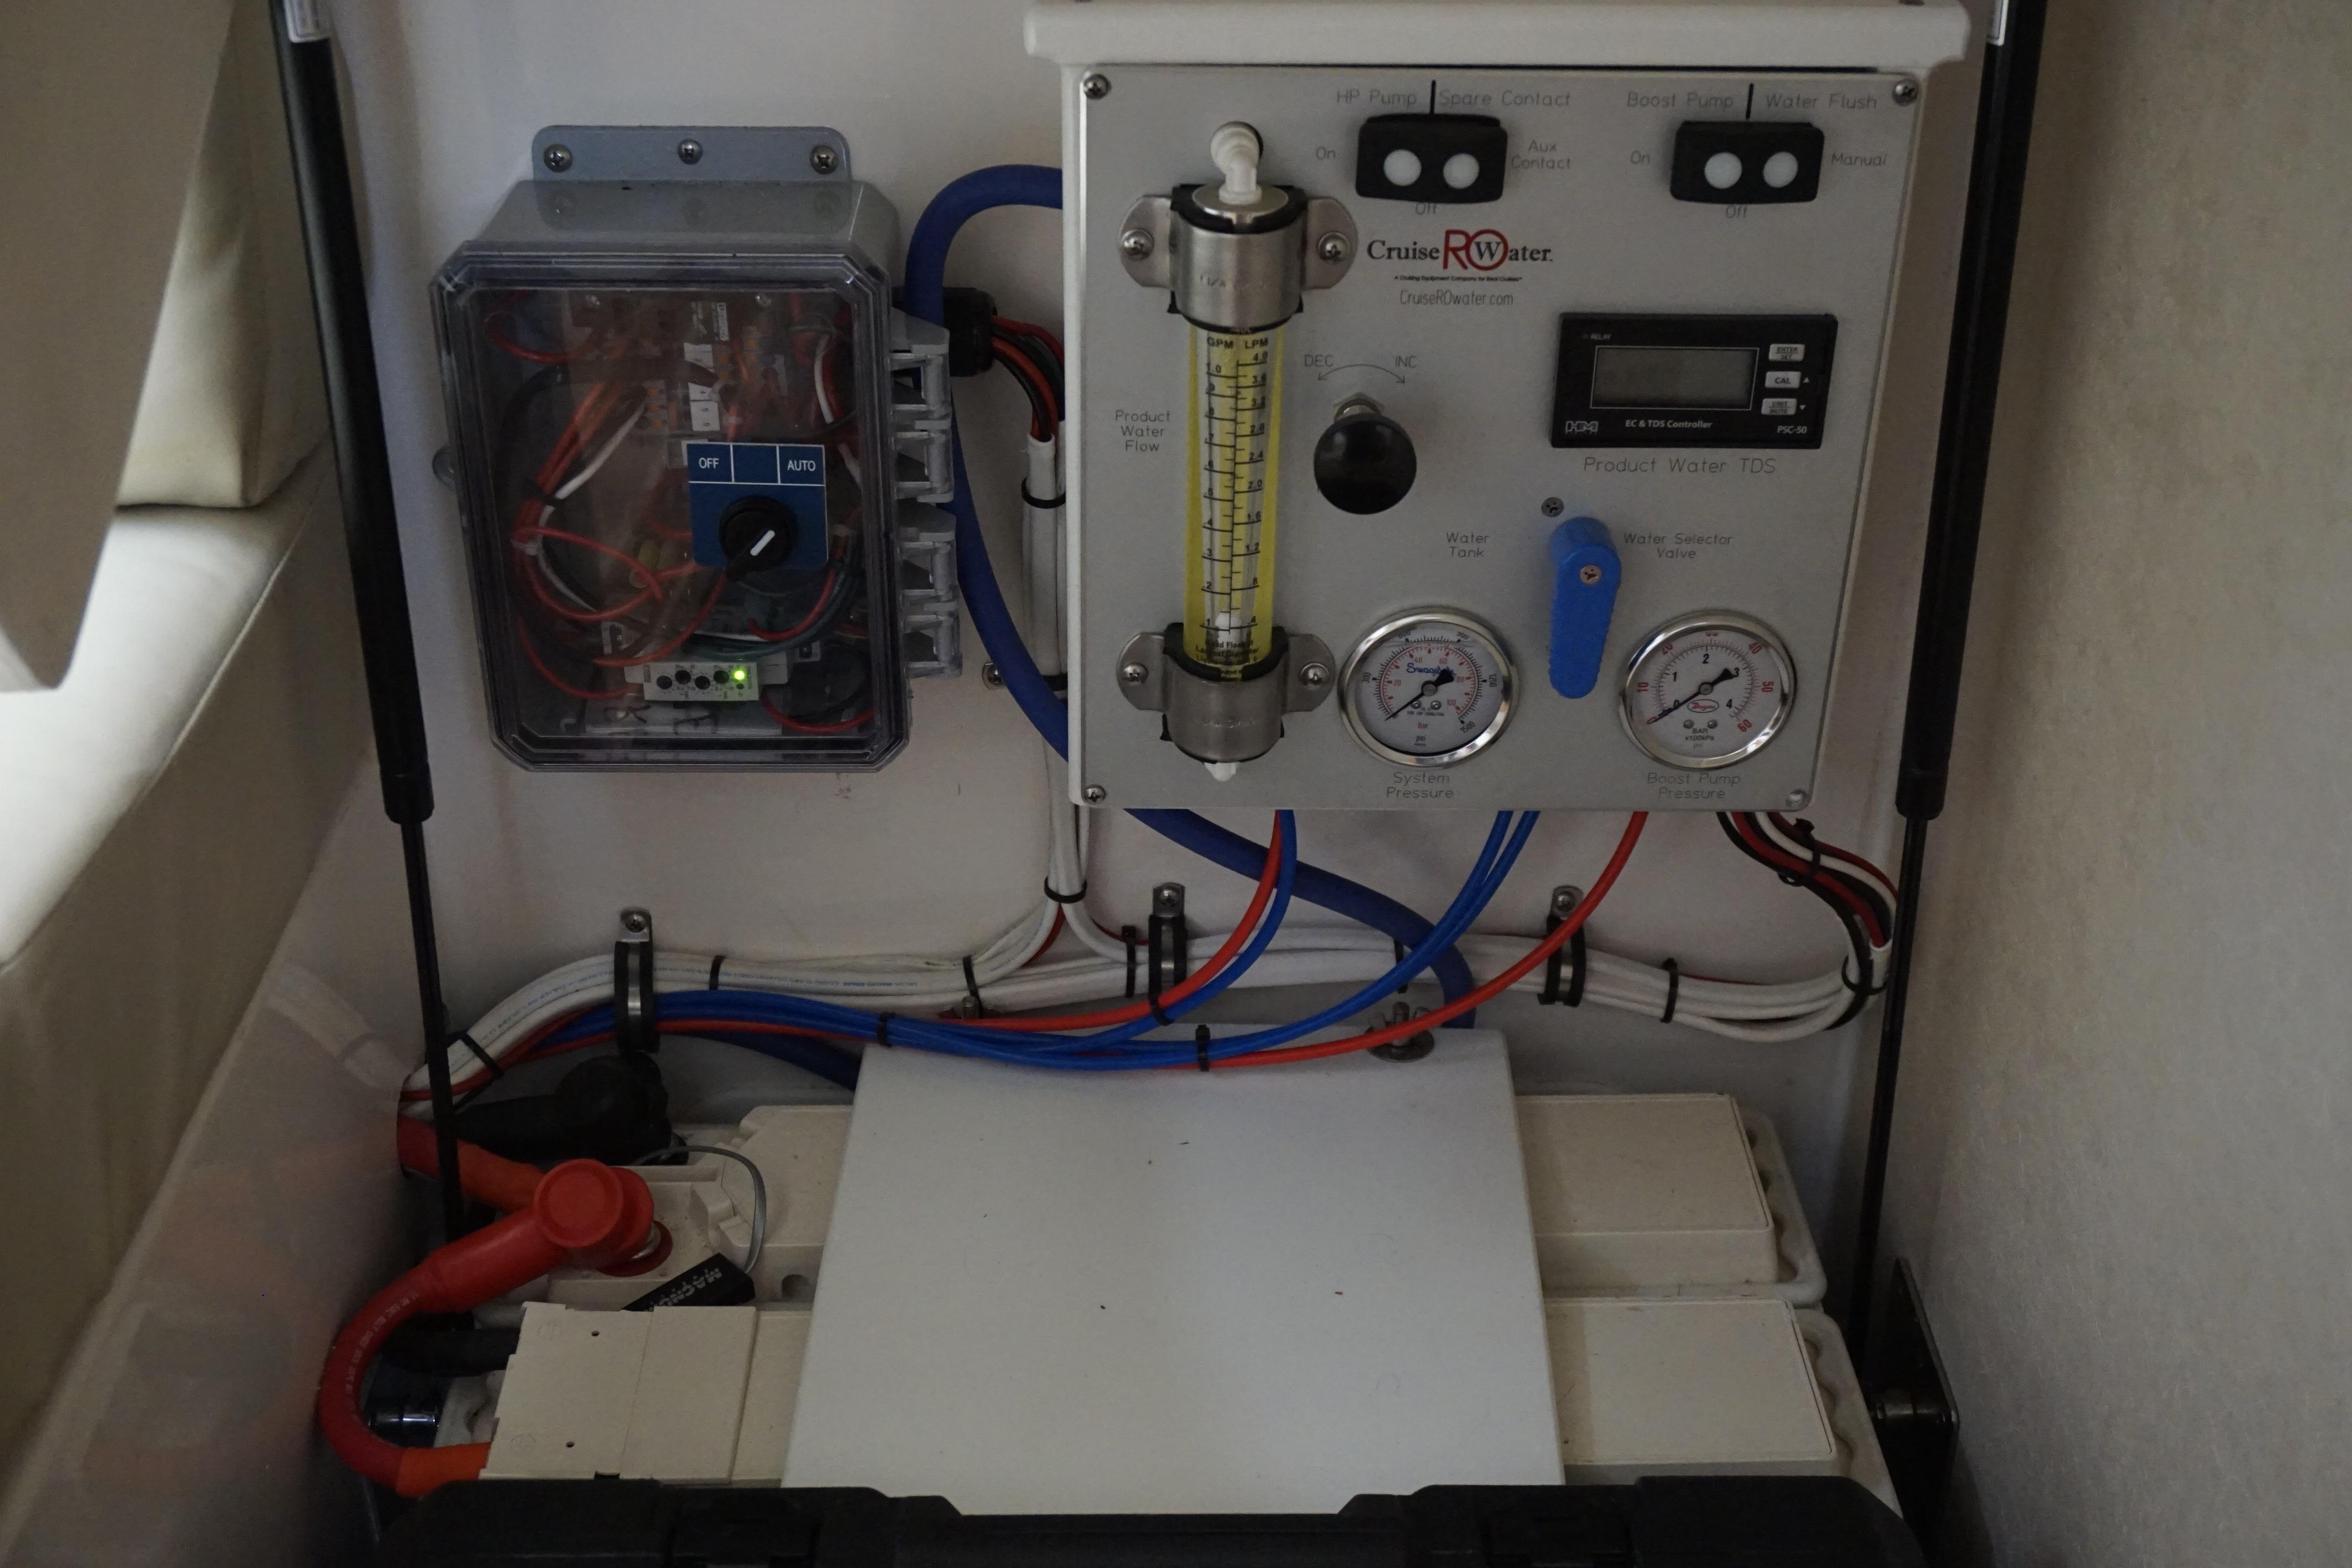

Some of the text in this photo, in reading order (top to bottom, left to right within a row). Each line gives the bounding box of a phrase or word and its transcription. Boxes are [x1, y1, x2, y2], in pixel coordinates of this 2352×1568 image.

[1337, 89, 1417, 106] HP Pump
[1439, 90, 1571, 106] Spare Contact
[1628, 92, 1733, 110] Boost Pump
[1766, 93, 1877, 109] Water Flush
[1316, 146, 1336, 160] On
[1528, 140, 1557, 153] Aux
[1511, 155, 1571, 170] Contact
[1630, 150, 1650, 165] On
[1832, 153, 1887, 166] Manual
[1416, 202, 1438, 215] Off
[1726, 205, 1748, 219] Off
[1207, 336, 1234, 348] GPM
[1245, 337, 1268, 349] LPM
[1304, 354, 1334, 368] DEC
[1395, 355, 1417, 368] INC
[1115, 409, 1171, 423] Product
[1625, 419, 1713, 429] EC & TDS Controller
[1777, 425, 1807, 434] PSC-50
[1121, 425, 1165, 438] Water
[1125, 439, 1160, 453] Flow
[698, 457, 720, 469] OFF
[787, 460, 817, 472] AUTO
[1584, 457, 1776, 474] Product Water TDS
[1446, 531, 1489, 544] Water
[1624, 532, 1734, 545] Water Selector
[1449, 546, 1484, 558] Tank
[1656, 548, 1696, 559] Valve
[1748, 642, 1762, 654] 40
[1702, 653, 1710, 664] 2
[1406, 662, 1457, 676] Swagelk
[1733, 667, 1740, 678] 3
[1361, 672, 1372, 684] 300
[1489, 674, 1498, 688] 1200
[1672, 671, 1677, 682] 1
[1636, 682, 1649, 693] 10
[1762, 681, 1775, 693] 50
[1673, 699, 1680, 709] 0
[1726, 699, 1733, 709] 4
[1460, 720, 1476, 734] 1500
[1737, 719, 1753, 733] 60
[1393, 772, 1450, 786] System
[1647, 772, 1741, 786] Boost Pump
[1386, 786, 1454, 799] Pressure
[1659, 786, 1726, 799] Pressure
[648, 1267, 723, 1311] MAGNU
